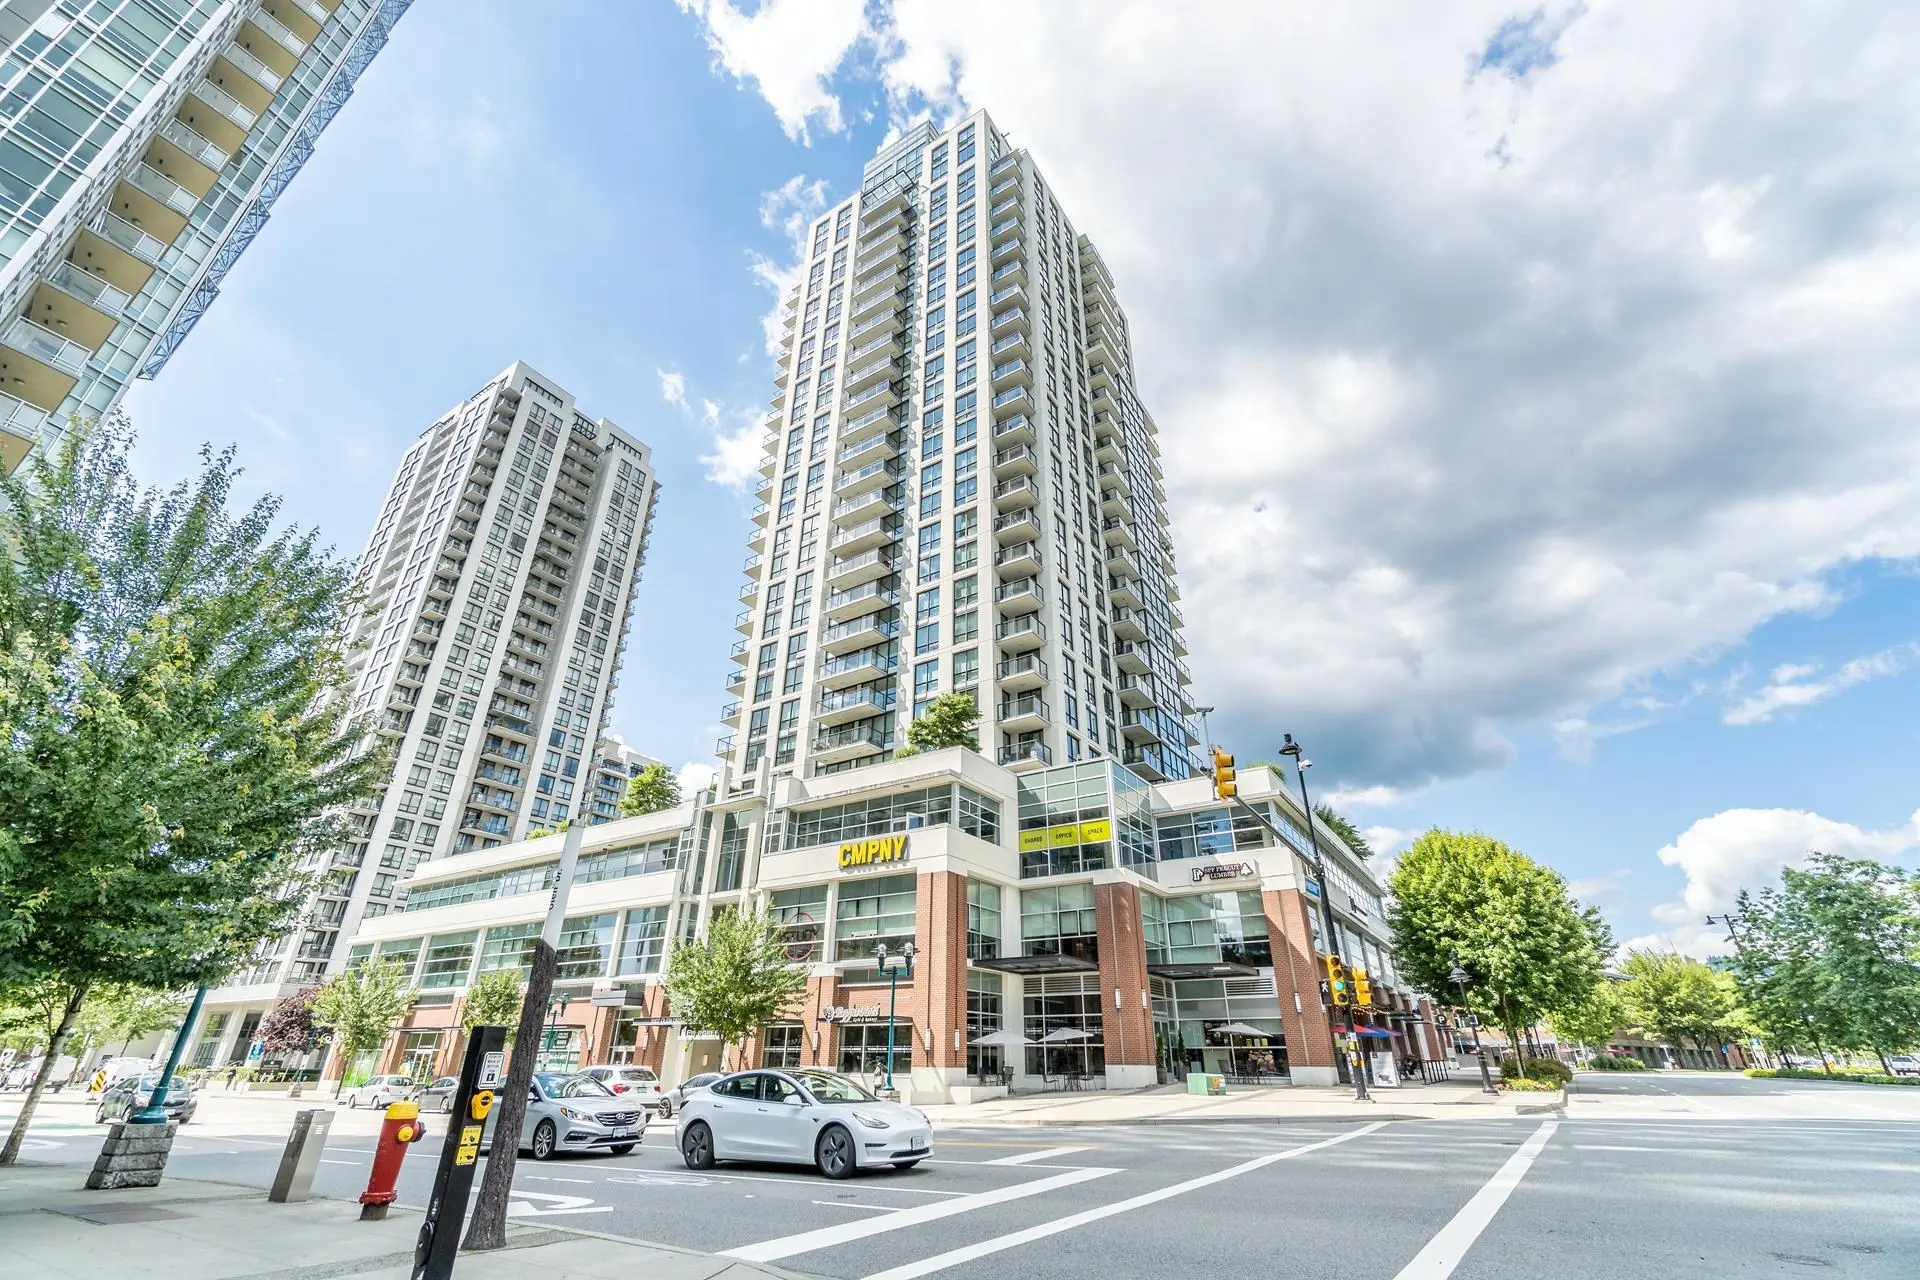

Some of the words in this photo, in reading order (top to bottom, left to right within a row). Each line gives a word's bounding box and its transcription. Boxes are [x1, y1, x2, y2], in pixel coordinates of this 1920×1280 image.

[1024, 836, 1043, 844] SHARED
[1087, 827, 1103, 835] SPACE
[838, 835, 906, 867] CMPNY
[1216, 864, 1240, 872] PRECUT
[1210, 871, 1236, 879] LUMBER
